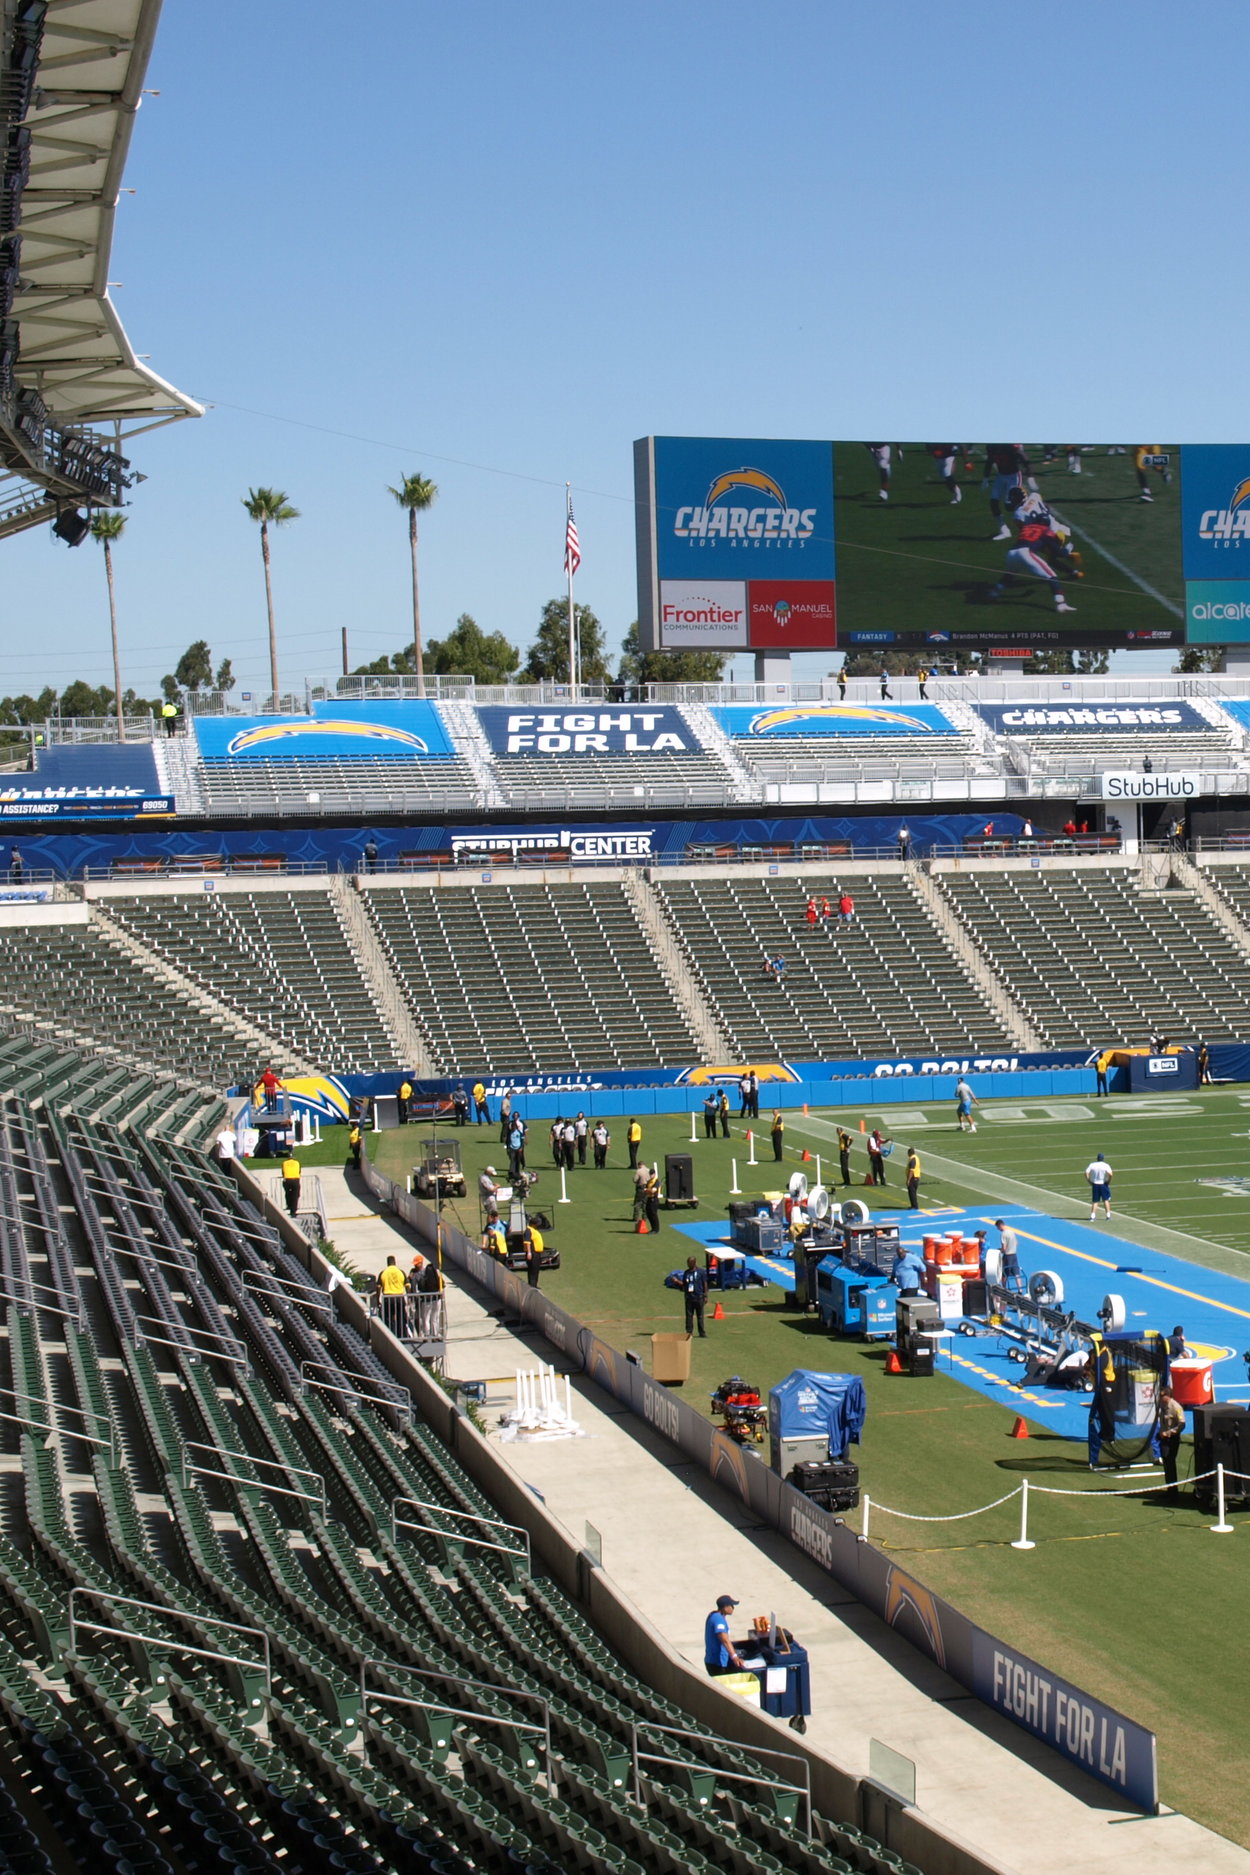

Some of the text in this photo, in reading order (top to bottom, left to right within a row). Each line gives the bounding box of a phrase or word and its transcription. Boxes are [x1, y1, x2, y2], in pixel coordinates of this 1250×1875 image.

[674, 506, 817, 538] CHARGERS
[689, 538, 806, 549] LOS ANGELES
[1214, 539, 1241, 549] LOS
[662, 604, 744, 623] Frontier
[752, 603, 833, 613] SAN MANUEL
[991, 649, 1032, 657] TOSHIBA
[507, 713, 664, 732] FIGHT
[1002, 709, 1182, 725] CHARGERS
[507, 733, 687, 752] FOR LA
[1108, 776, 1194, 797] StubHub
[3, 803, 59, 814] ASSISTANCE?
[142, 800, 169, 810] 69050
[571, 836, 651, 856] CENTER
[1160, 1060, 1176, 1070] NFL
[491, 1075, 593, 1087] LOS ANGELES
[643, 1382, 680, 1443] GO BOLTS!
[790, 1505, 833, 1571] CHARGERS
[993, 1650, 1127, 1786] FIGHT FOR LA
